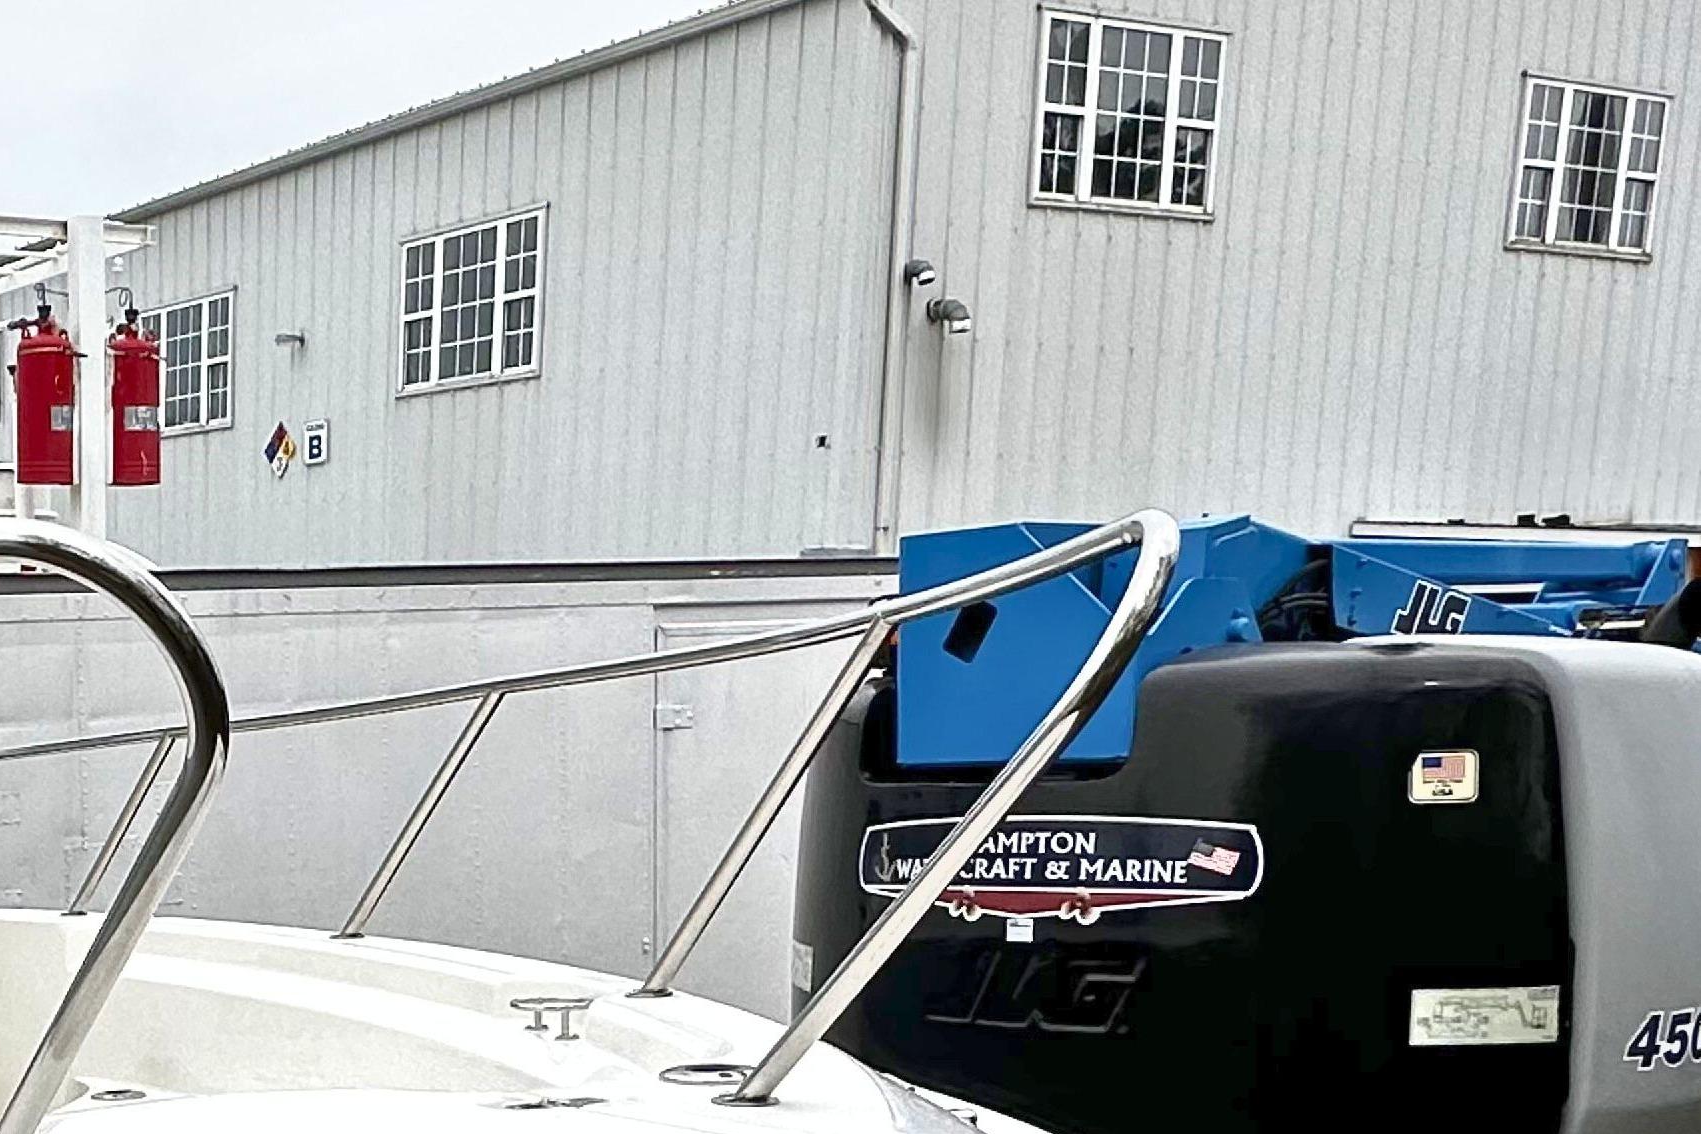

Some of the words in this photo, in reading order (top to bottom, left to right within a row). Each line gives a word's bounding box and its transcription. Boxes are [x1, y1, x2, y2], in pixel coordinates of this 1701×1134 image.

[308, 434, 322, 460] B
[1390, 579, 1473, 635] JLG
[978, 831, 1097, 855] AMPTON
[1044, 860, 1072, 880] &
[1077, 858, 1189, 884] MARINE
